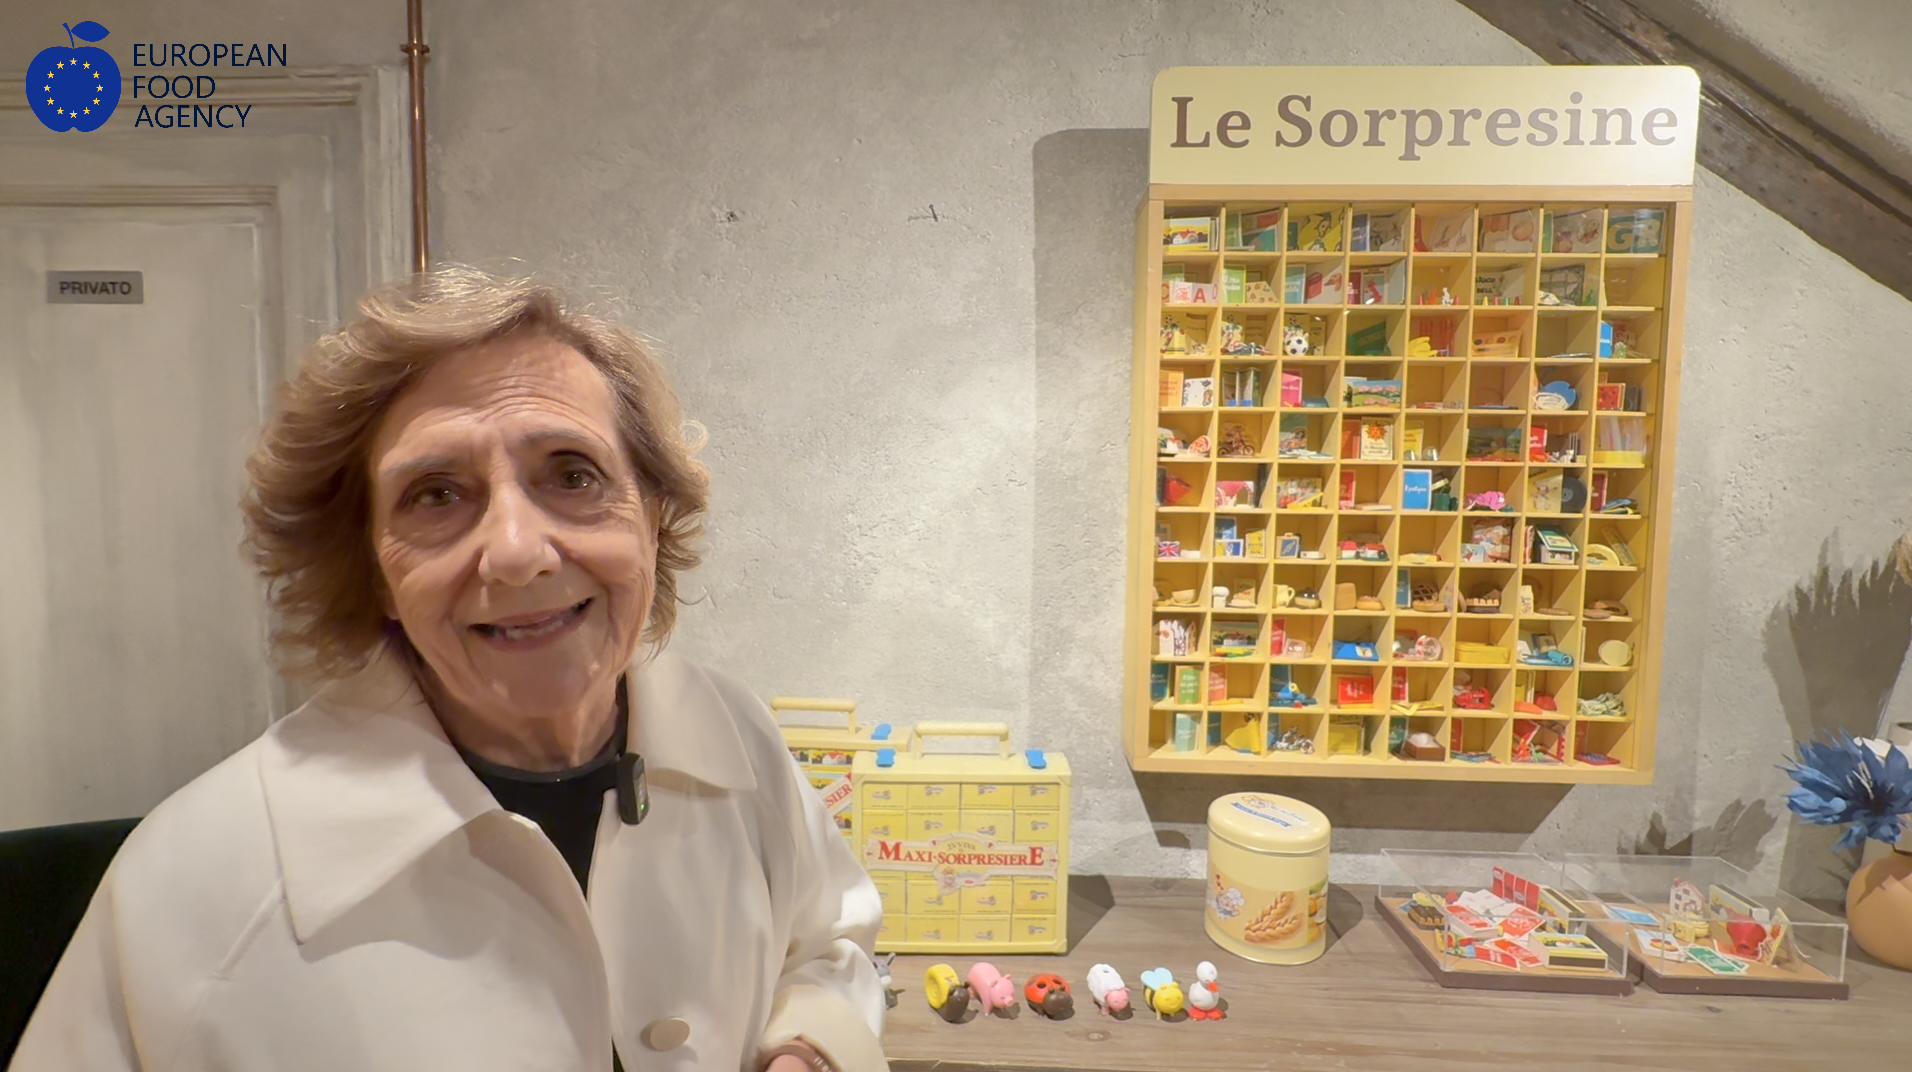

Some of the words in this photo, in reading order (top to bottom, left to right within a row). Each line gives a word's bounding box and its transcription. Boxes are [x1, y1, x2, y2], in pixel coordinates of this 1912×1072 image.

[1170, 95, 1252, 148] Le
[1275, 91, 1679, 161] Sorpresine
[59, 281, 132, 296] PRIVATO
[1193, 287, 1207, 303] A
[824, 783, 852, 809] SIER
